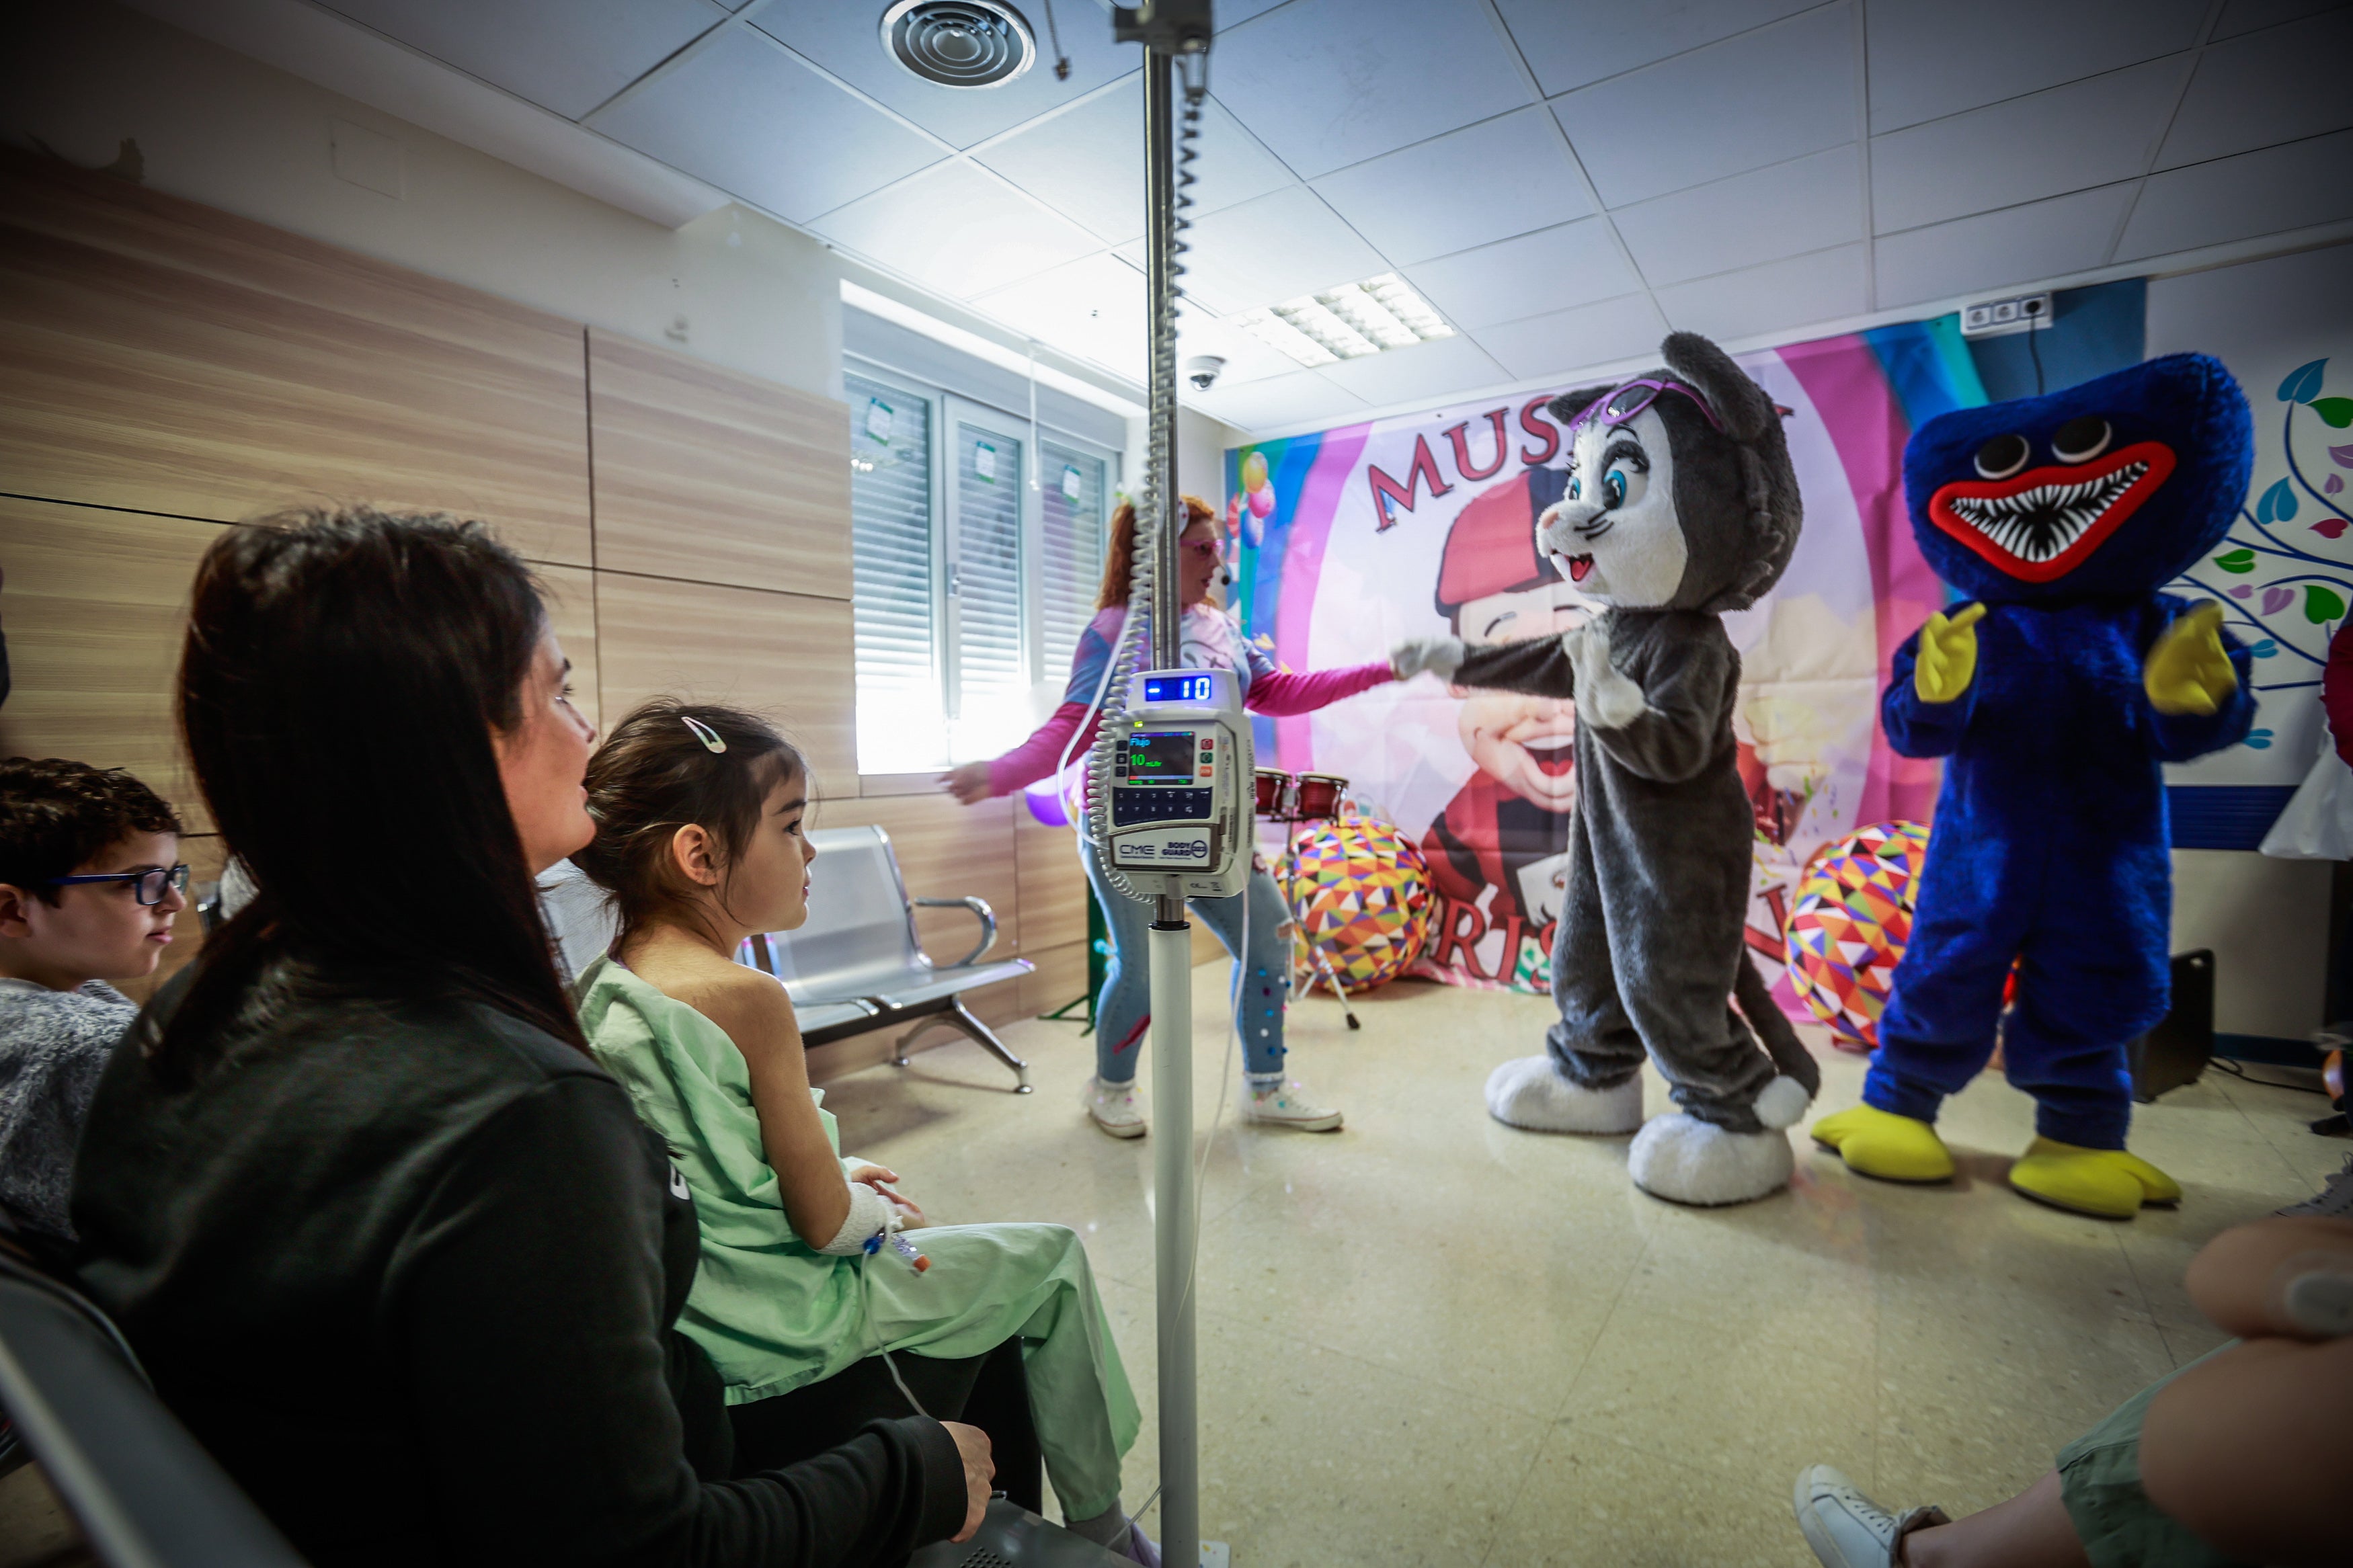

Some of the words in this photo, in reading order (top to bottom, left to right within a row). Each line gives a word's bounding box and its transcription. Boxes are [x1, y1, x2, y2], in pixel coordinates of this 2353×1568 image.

[1367, 394, 1574, 533] MUS
[1183, 677, 1210, 700] 10
[1130, 753, 1146, 766] 10
[1119, 844, 1155, 855] CME
